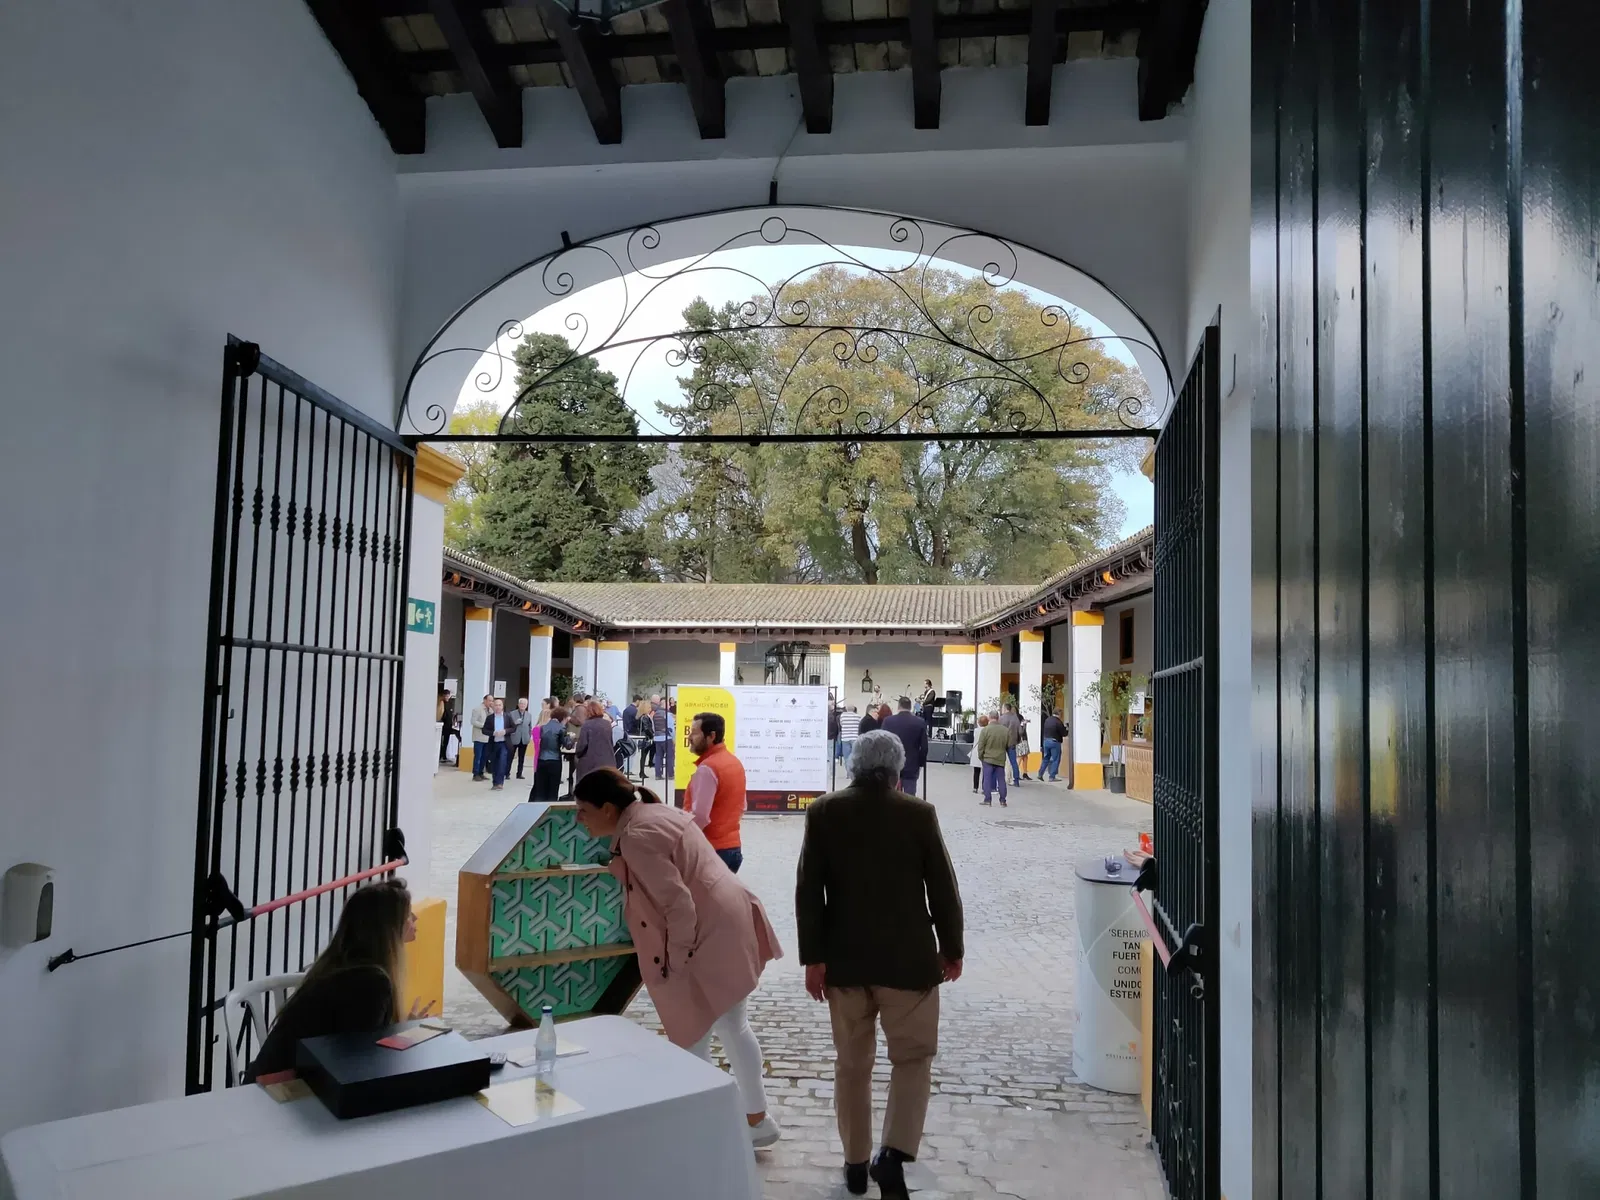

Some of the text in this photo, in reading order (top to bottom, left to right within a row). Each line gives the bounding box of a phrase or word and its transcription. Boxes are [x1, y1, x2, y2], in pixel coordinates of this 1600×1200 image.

[1122, 941, 1141, 950] TAN
[1112, 951, 1141, 961] FUERT
[1110, 989, 1142, 999] ESTEM
